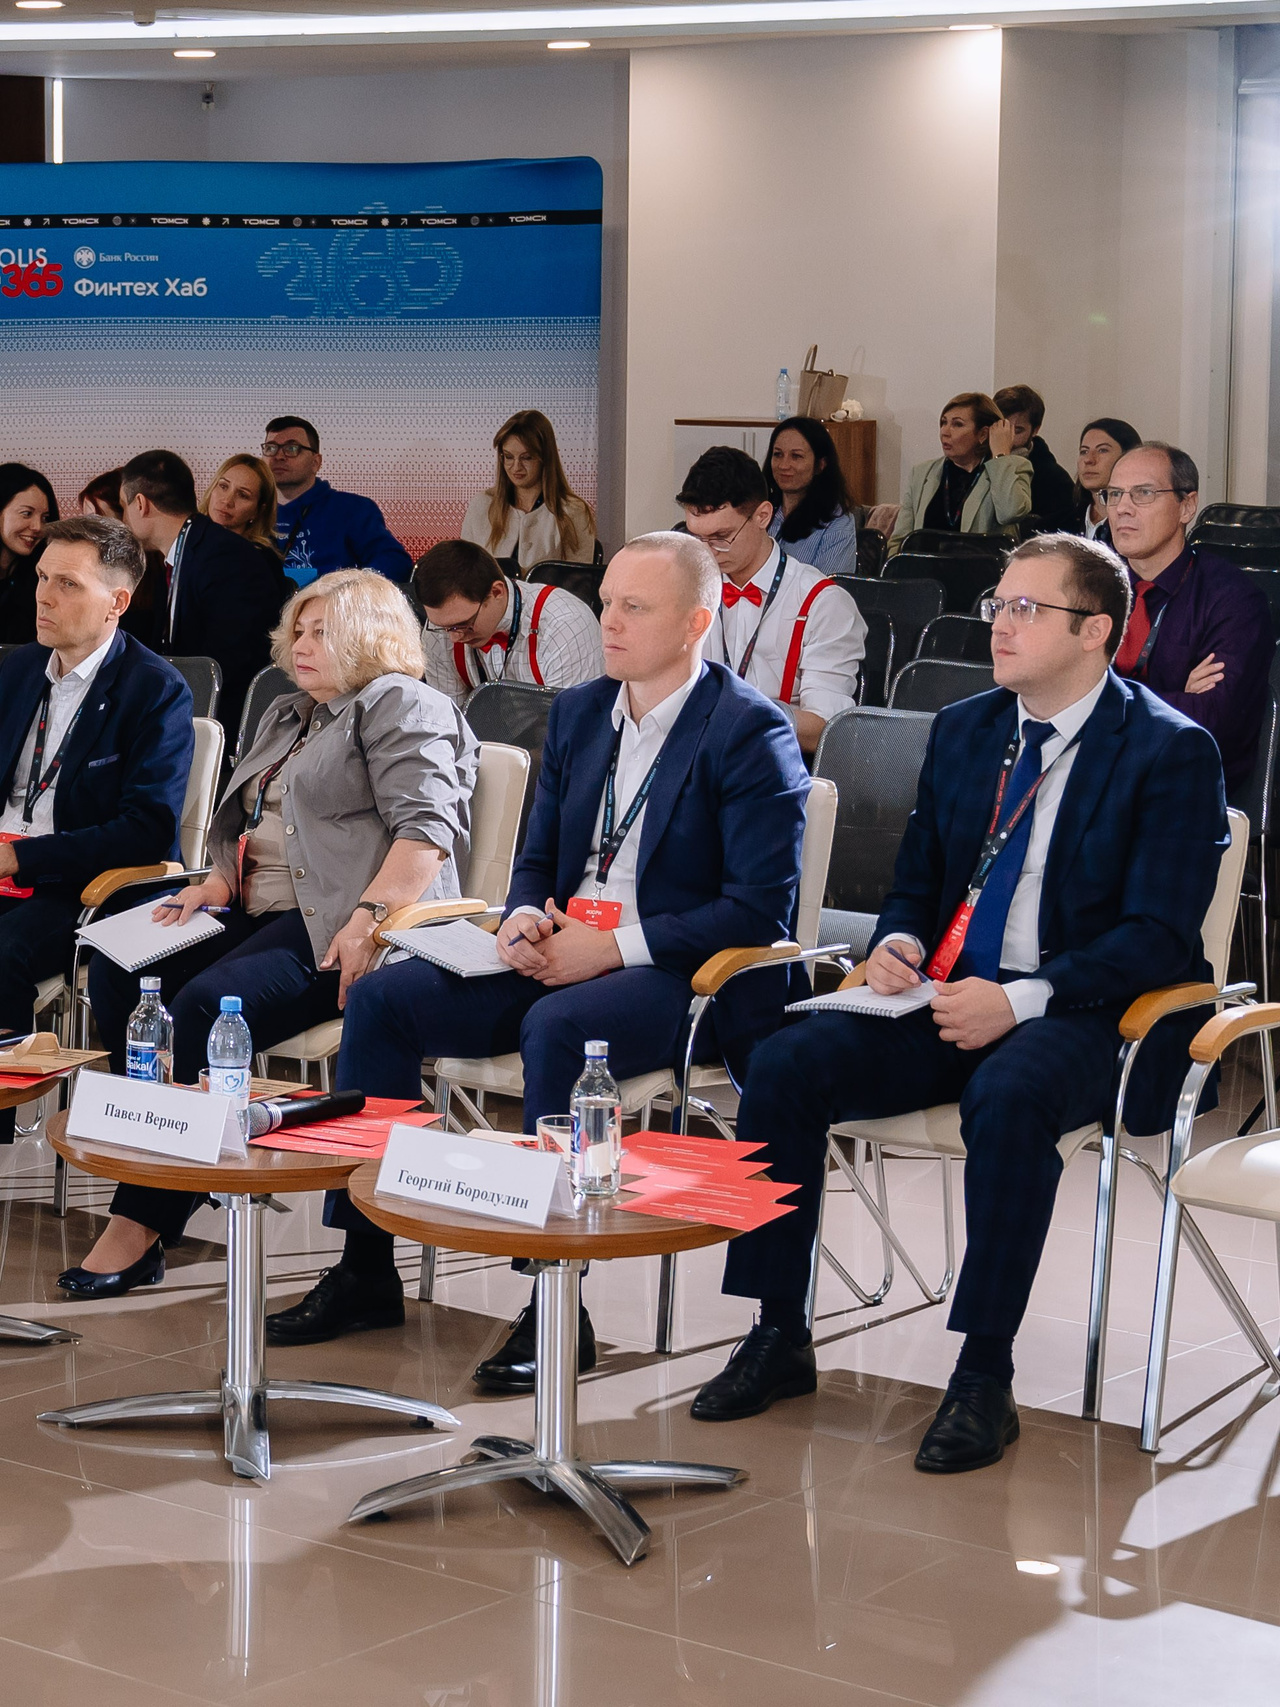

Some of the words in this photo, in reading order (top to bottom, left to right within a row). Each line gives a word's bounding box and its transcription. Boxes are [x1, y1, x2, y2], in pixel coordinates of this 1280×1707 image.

[62, 217, 100, 225] ТОМСК
[150, 217, 189, 225] ТОМСК
[242, 218, 280, 226] ТОМСК
[331, 218, 368, 226] ТОМСК
[420, 217, 457, 225] ТОМСК
[508, 214, 547, 223] ТОМСК
[99, 252, 122, 263] Банк
[124, 252, 159, 263] России
[1, 257, 64, 298] 365
[74, 277, 159, 297] Финтех
[164, 277, 208, 297] Хаб
[102, 1101, 141, 1126] Павел
[143, 1108, 190, 1135] Вернер
[396, 1167, 453, 1196] Георгий
[454, 1178, 530, 1210] Бородулин
